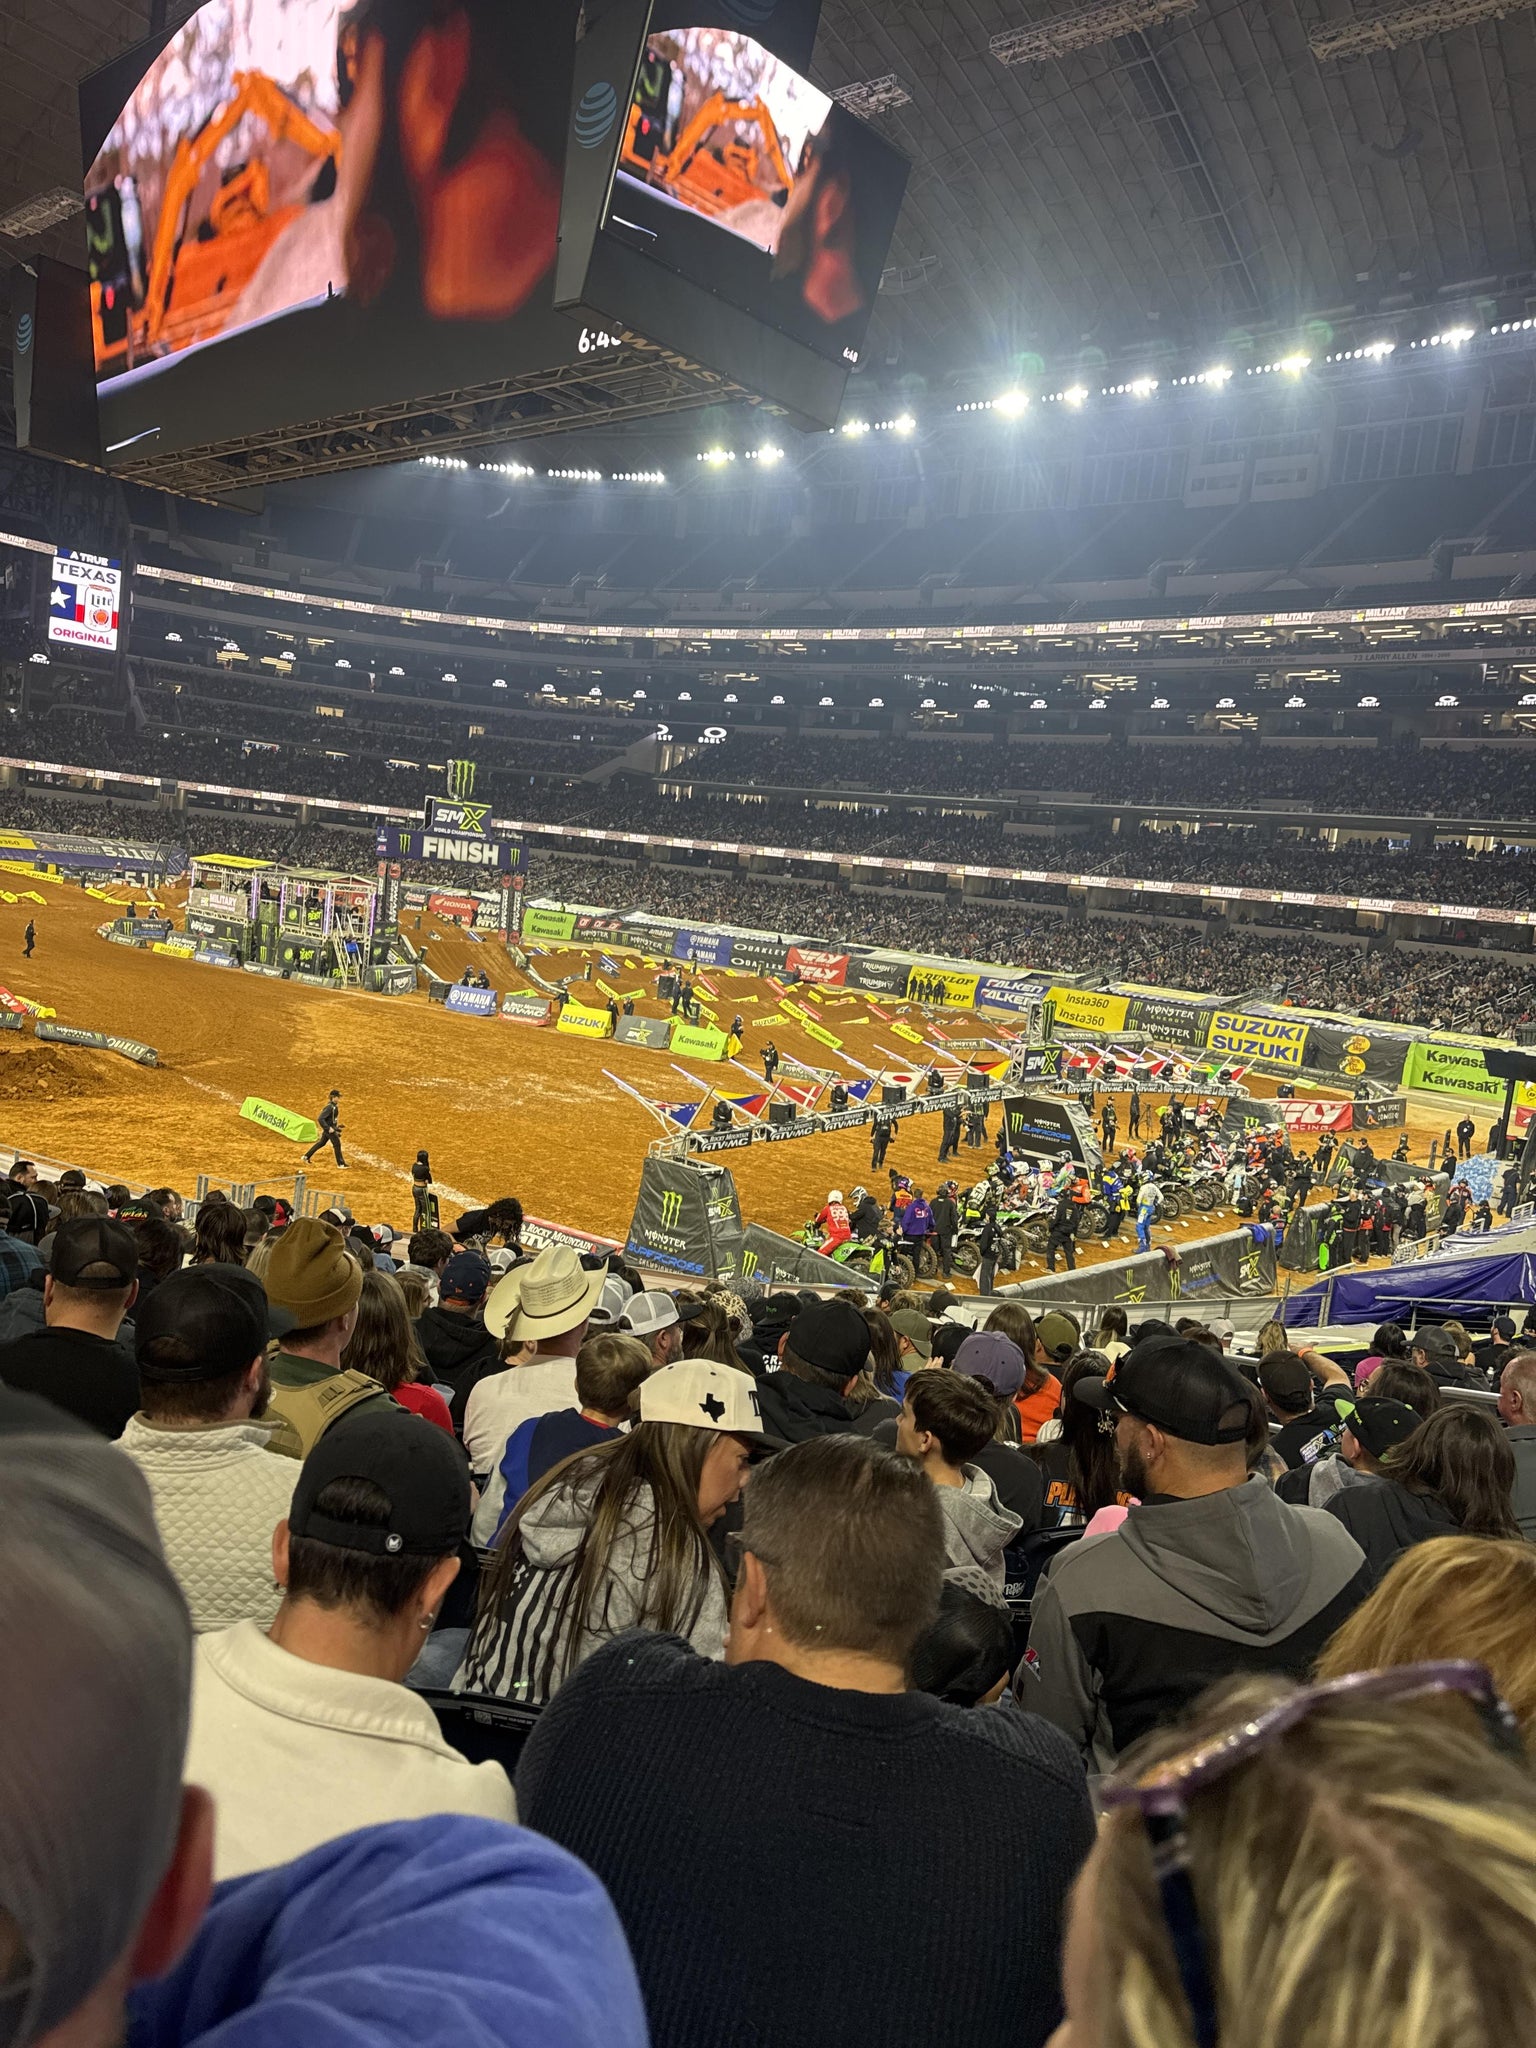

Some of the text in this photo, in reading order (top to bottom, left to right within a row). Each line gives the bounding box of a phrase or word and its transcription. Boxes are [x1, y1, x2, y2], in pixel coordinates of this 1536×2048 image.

[70, 551, 109, 566] A TRUE
[57, 562, 117, 585] TEXAS
[1365, 607, 1409, 618] MILITARY
[1465, 601, 1513, 612] MILITARY
[1188, 617, 1227, 627] MILITARY
[1274, 612, 1314, 622] MILITARY
[53, 627, 113, 645] ORIGINAL
[1365, 653, 1390, 661] LARRY
[1391, 652, 1418, 661] ALLEN
[435, 807, 487, 833] SMX
[422, 836, 499, 866] FINISH
[443, 901, 471, 910] HONDA
[1441, 905, 1479, 916] MILITARY
[534, 912, 567, 923] Kawasaki
[531, 925, 564, 936] Kawasaki
[580, 930, 608, 939] MONSTER
[631, 936, 663, 949] MONSTER
[696, 936, 719, 946] YAMAHA
[748, 945, 786, 957] OAKLEY
[797, 949, 845, 964] FLY
[794, 964, 839, 979] FLY
[862, 962, 890, 973] TRIUMPH
[859, 977, 887, 989] TRIUMPH
[924, 973, 974, 986] DUNLOP
[986, 979, 1043, 993] FALKEN
[460, 991, 491, 1006] YAMAHA
[981, 989, 1032, 1006] FALKE
[1066, 994, 1109, 1009] Insta360
[1059, 1009, 1105, 1027] Insta360
[1145, 1004, 1194, 1020] MONSTER
[561, 1015, 606, 1029] SUZUKI
[1216, 1016, 1304, 1042] SUZUKI
[56, 1026, 92, 1037] MONSTER
[1141, 1022, 1190, 1039] MONSTER
[678, 1035, 718, 1049] Kawasaki
[1154, 1034, 1182, 1043] NERGY
[1212, 1035, 1299, 1063] SUZUKI
[1026, 1051, 1060, 1074] SMX
[1426, 1050, 1487, 1069] Kawasa
[1422, 1071, 1498, 1095] Kawasaki
[252, 1105, 290, 1131] Kawasaki
[1280, 1102, 1343, 1124] FLY
[1034, 1118, 1061, 1128] MONSTER
[708, 1199, 734, 1218] SMX
[527, 1223, 593, 1250] ROCKY MOUNTAIN
[645, 1229, 686, 1250] MONSTER
[627, 1243, 705, 1275] SUPERCROSS
[775, 1266, 800, 1282] ONSTER
